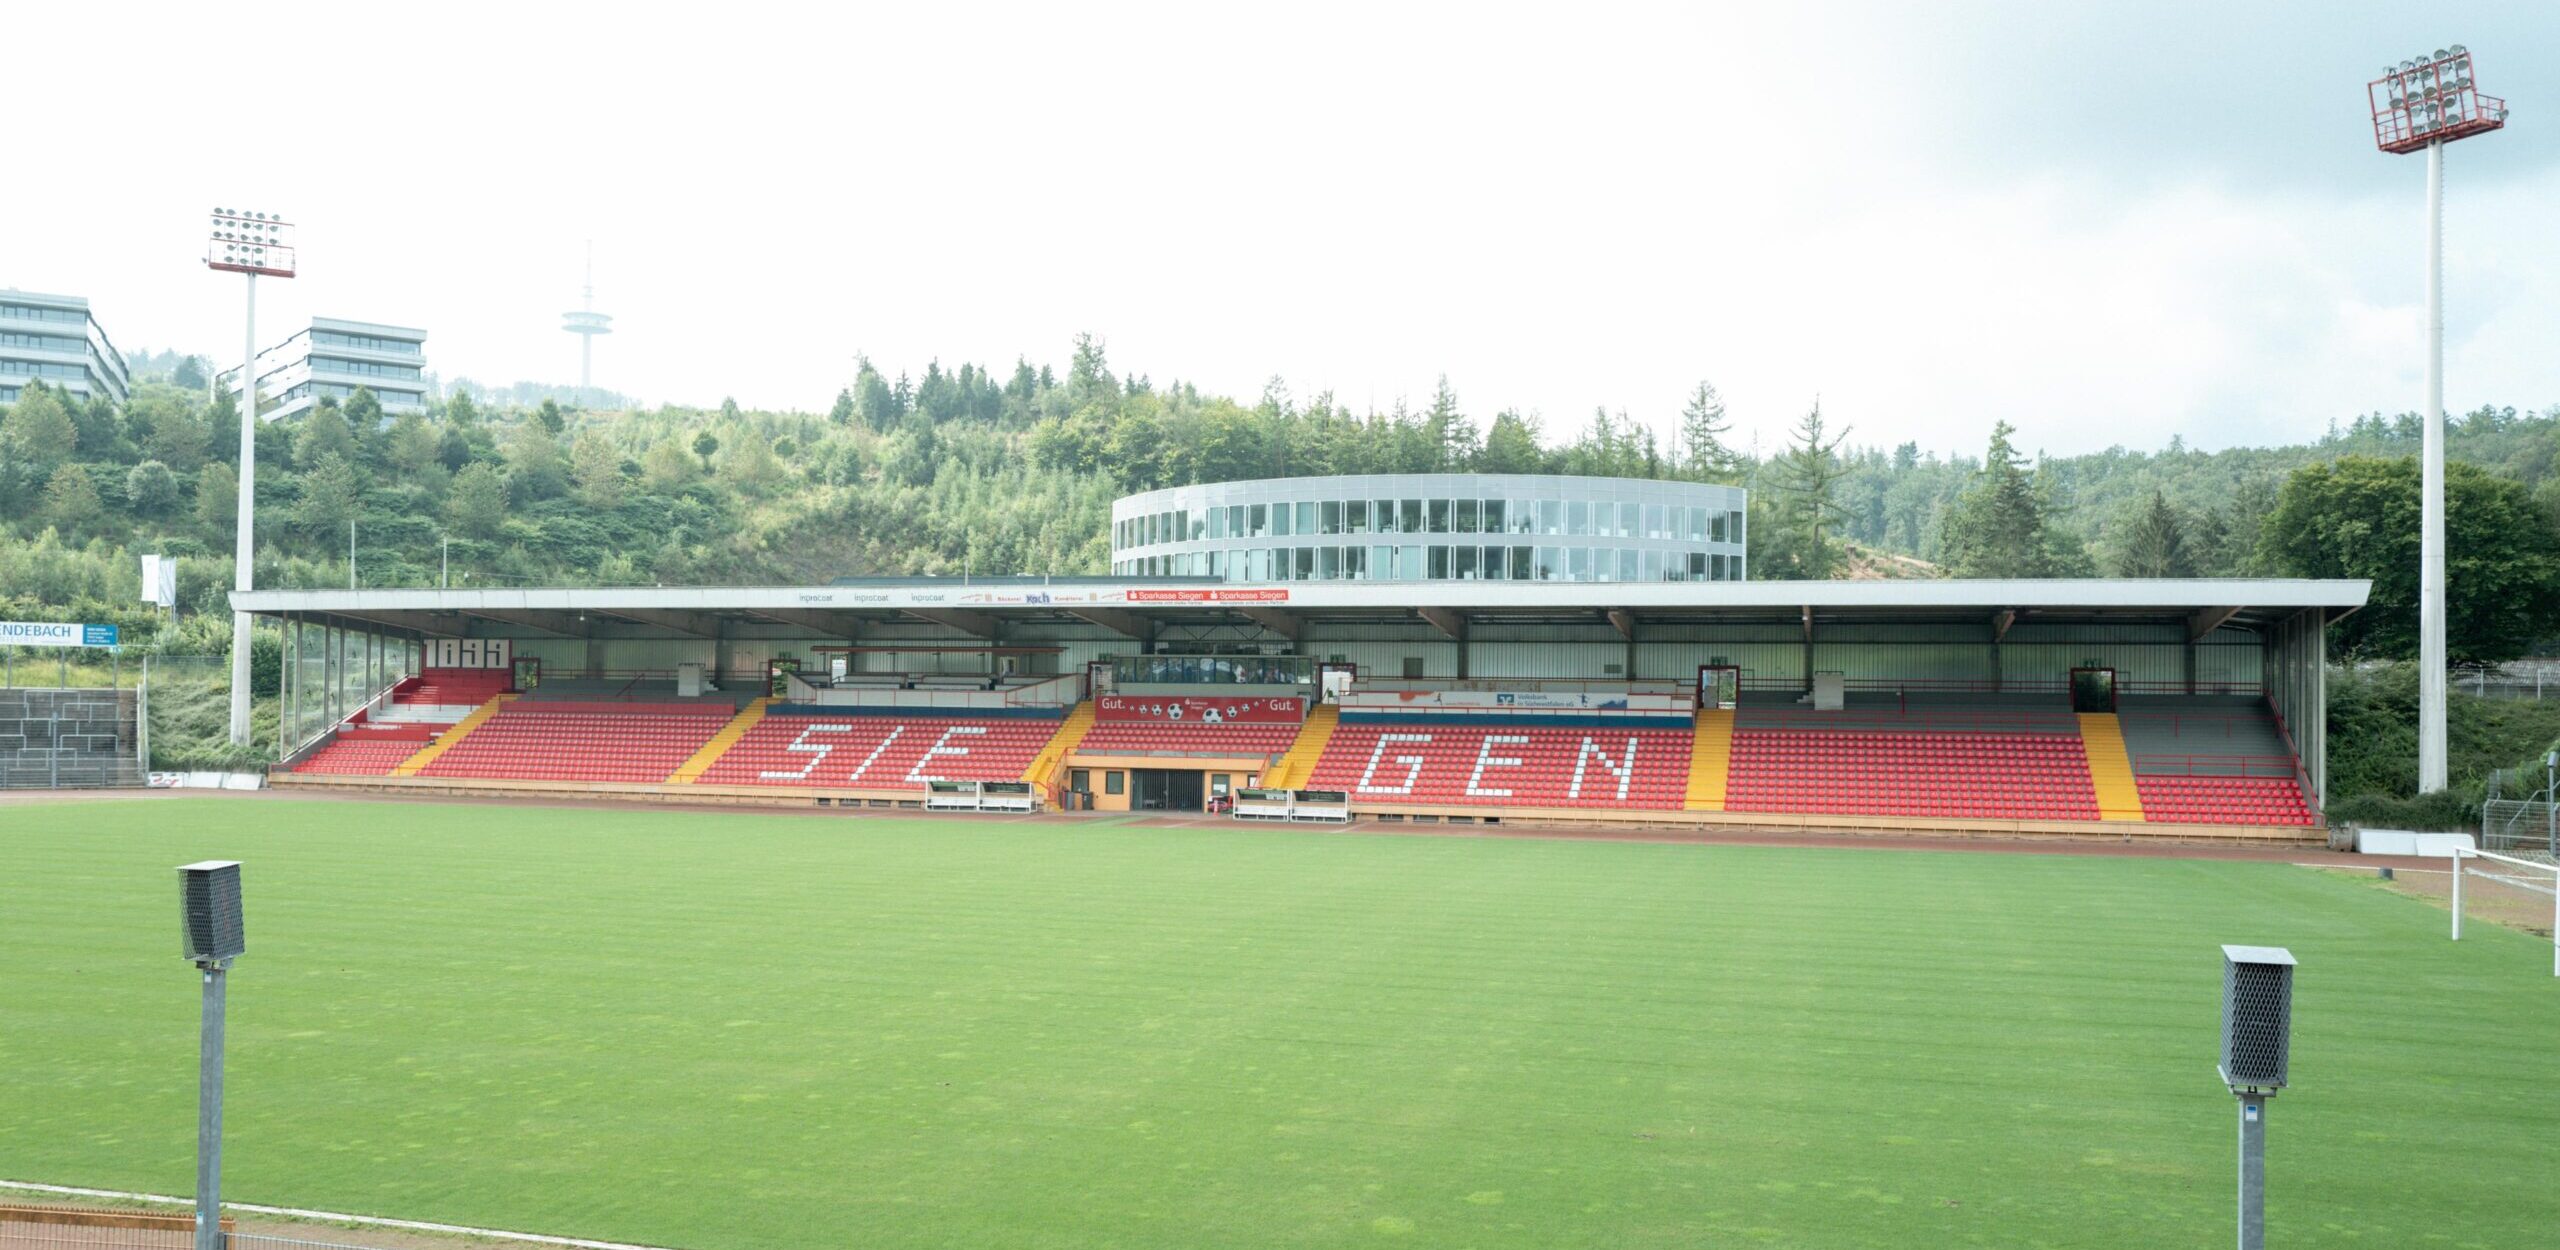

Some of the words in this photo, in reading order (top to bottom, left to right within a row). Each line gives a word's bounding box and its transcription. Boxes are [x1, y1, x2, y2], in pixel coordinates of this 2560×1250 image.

[1025, 592, 1050, 604] Koch
[1139, 591, 1177, 600] Sparkasse
[1178, 591, 1204, 601] Siegen
[1219, 591, 1258, 600] Sparkasse
[1260, 591, 1286, 601] Siegen
[1102, 699, 1125, 709] Gut.
[1270, 700, 1294, 711] Gut.
